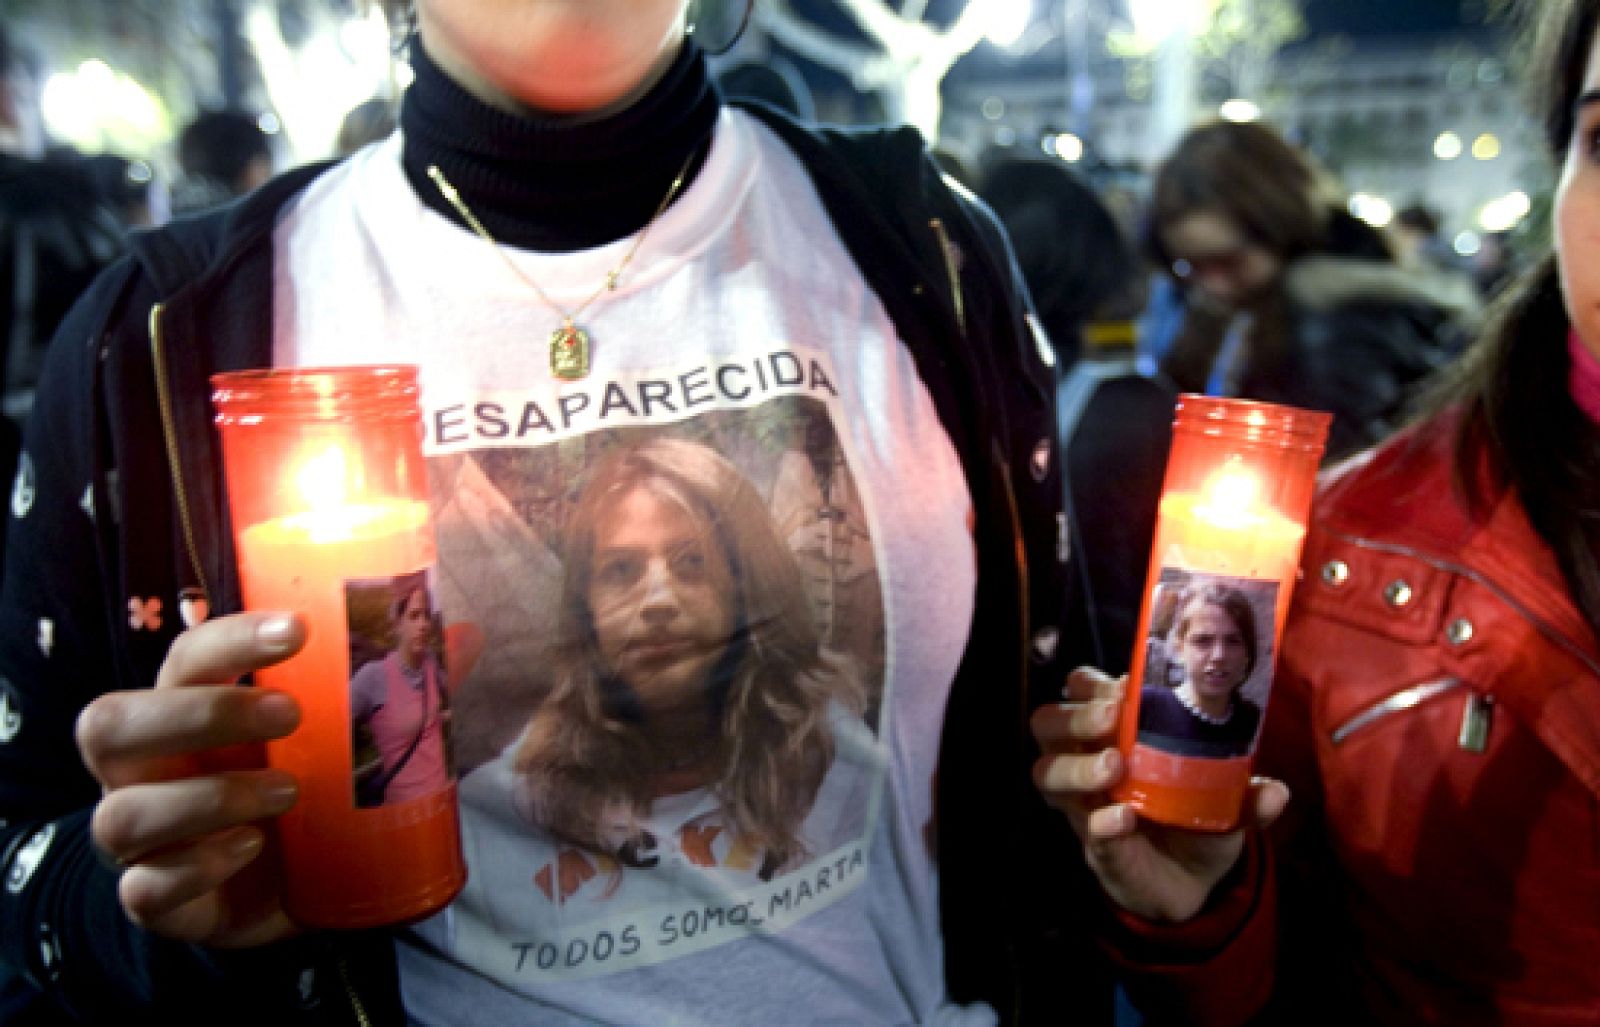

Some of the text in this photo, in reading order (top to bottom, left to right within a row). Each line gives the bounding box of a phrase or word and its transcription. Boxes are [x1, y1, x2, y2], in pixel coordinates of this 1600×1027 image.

[421, 351, 839, 446] ESAPARECIDA
[511, 925, 641, 972] TODOS
[767, 848, 863, 918] MARTA
